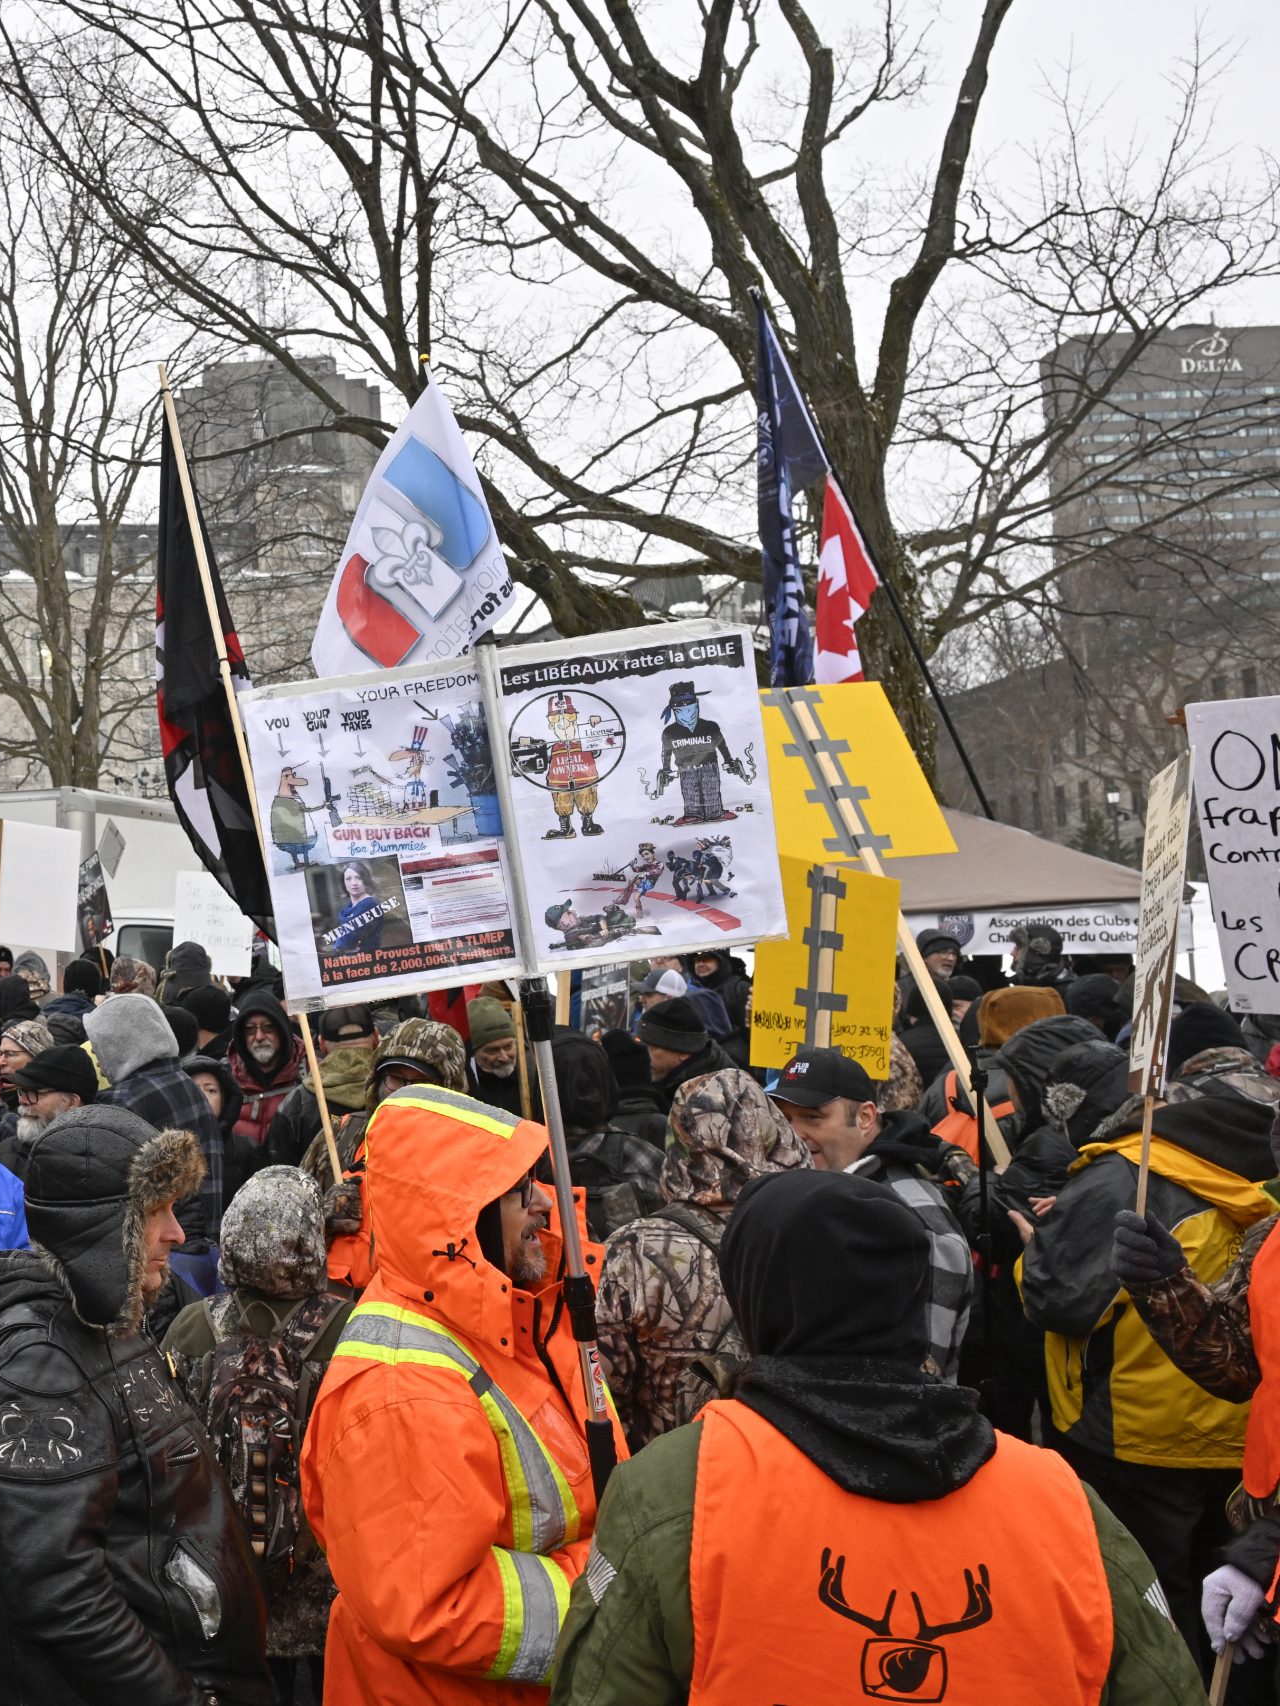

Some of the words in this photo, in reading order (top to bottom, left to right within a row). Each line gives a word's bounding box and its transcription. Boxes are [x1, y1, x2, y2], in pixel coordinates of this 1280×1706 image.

[1180, 358, 1244, 373] DELTA
[503, 674, 530, 687] Les
[534, 659, 619, 681] LIBÉRAUX
[623, 654, 664, 670] ratte
[670, 651, 685, 663] la
[689, 642, 735, 660] CIBLE
[357, 687, 400, 704] YOUR
[404, 673, 479, 696] FREEDOM
[303, 709, 330, 722] YOUR
[341, 709, 369, 722] YOUR
[265, 717, 290, 731] YOU
[306, 719, 327, 732] GUN
[341, 719, 372, 733] TAXES
[585, 728, 615, 737] License
[672, 736, 712, 748] CRIMINALS
[556, 754, 584, 766] LEGAL
[552, 763, 589, 777] OWNERS
[333, 827, 362, 841] GUN
[348, 841, 368, 856] for
[371, 840, 428, 855] Dummies
[322, 896, 401, 945] MENTEUSE
[989, 916, 1064, 928] Association
[1066, 915, 1091, 926] des
[1092, 915, 1130, 926] Clubs
[1221, 911, 1263, 932] Les
[989, 932, 1015, 943] Cha
[1079, 930, 1096, 942] du
[375, 945, 420, 961] Provost
[424, 940, 453, 954] ment
[456, 935, 464, 949] à
[466, 931, 505, 947] TLMEP
[322, 971, 330, 982] à
[333, 970, 343, 981] la
[345, 966, 371, 979] face
[373, 962, 387, 974] de
